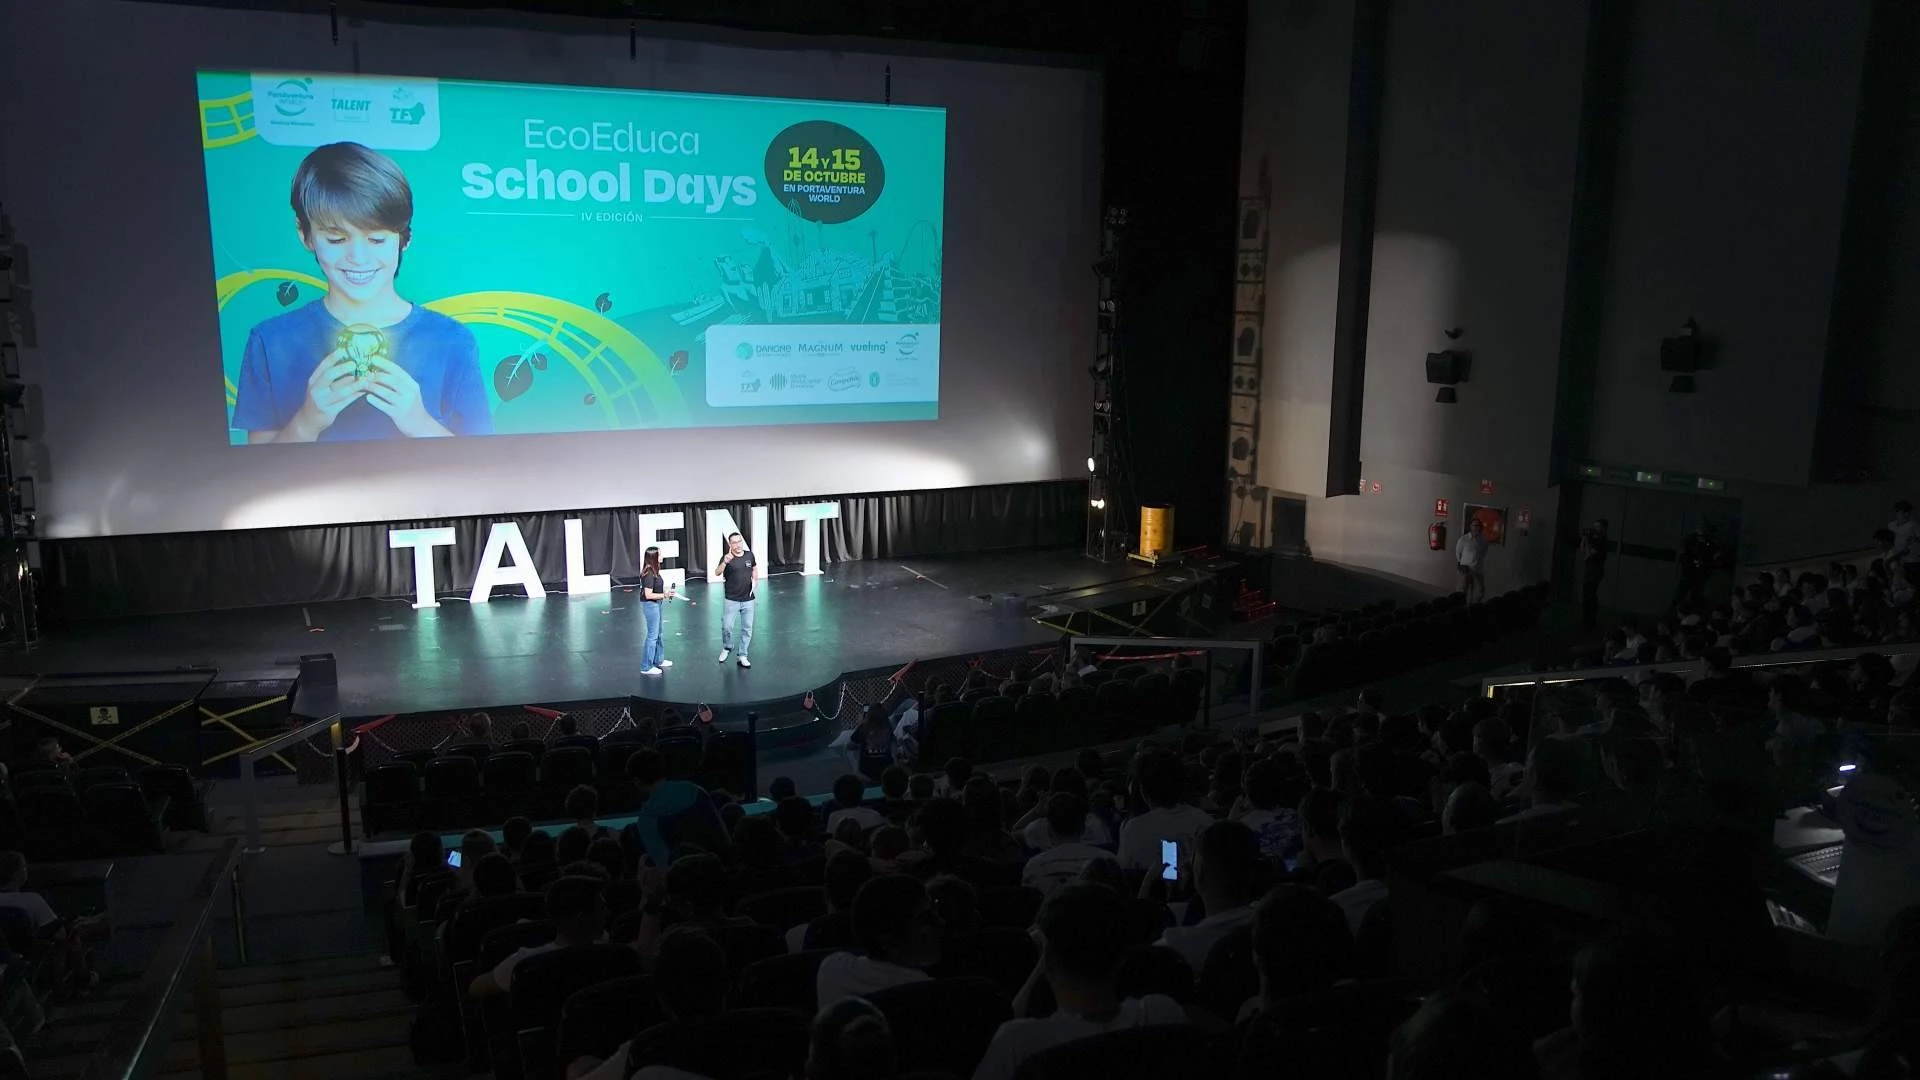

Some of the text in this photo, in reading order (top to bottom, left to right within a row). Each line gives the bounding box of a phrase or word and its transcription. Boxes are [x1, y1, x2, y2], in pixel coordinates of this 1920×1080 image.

[331, 99, 371, 111] TALENT
[524, 119, 700, 156] EcoEduca
[789, 147, 819, 169] 14
[831, 149, 861, 171] 15
[783, 170, 866, 184] DE OCTUBRE
[461, 159, 757, 214] School Days
[783, 184, 866, 195] EN PORTAVENTURA
[808, 194, 841, 204] WORLD
[581, 211, 644, 224] IV EDICIÓN
[389, 502, 840, 608] TALENT
